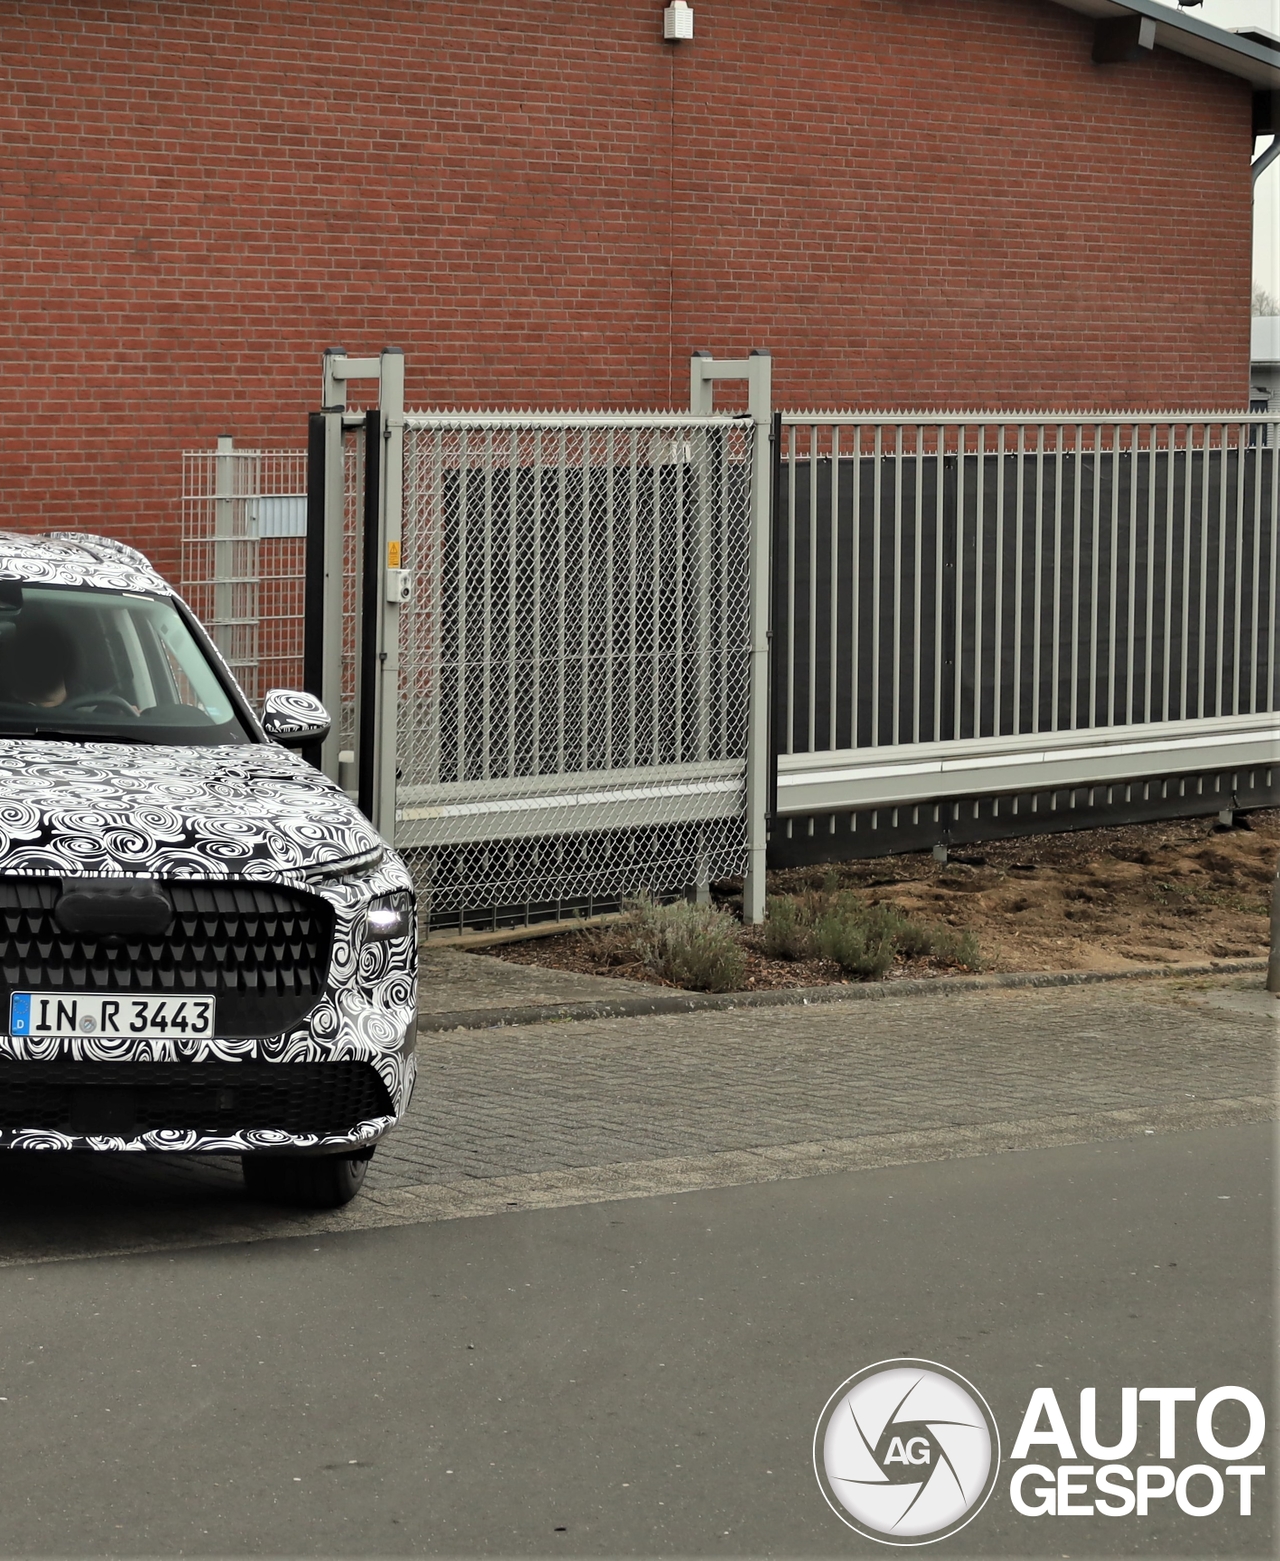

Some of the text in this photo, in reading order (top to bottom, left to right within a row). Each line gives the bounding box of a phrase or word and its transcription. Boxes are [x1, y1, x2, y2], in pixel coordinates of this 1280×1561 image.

[17, 1020, 24, 1029] D
[36, 1000, 210, 1033] IN R 3443
